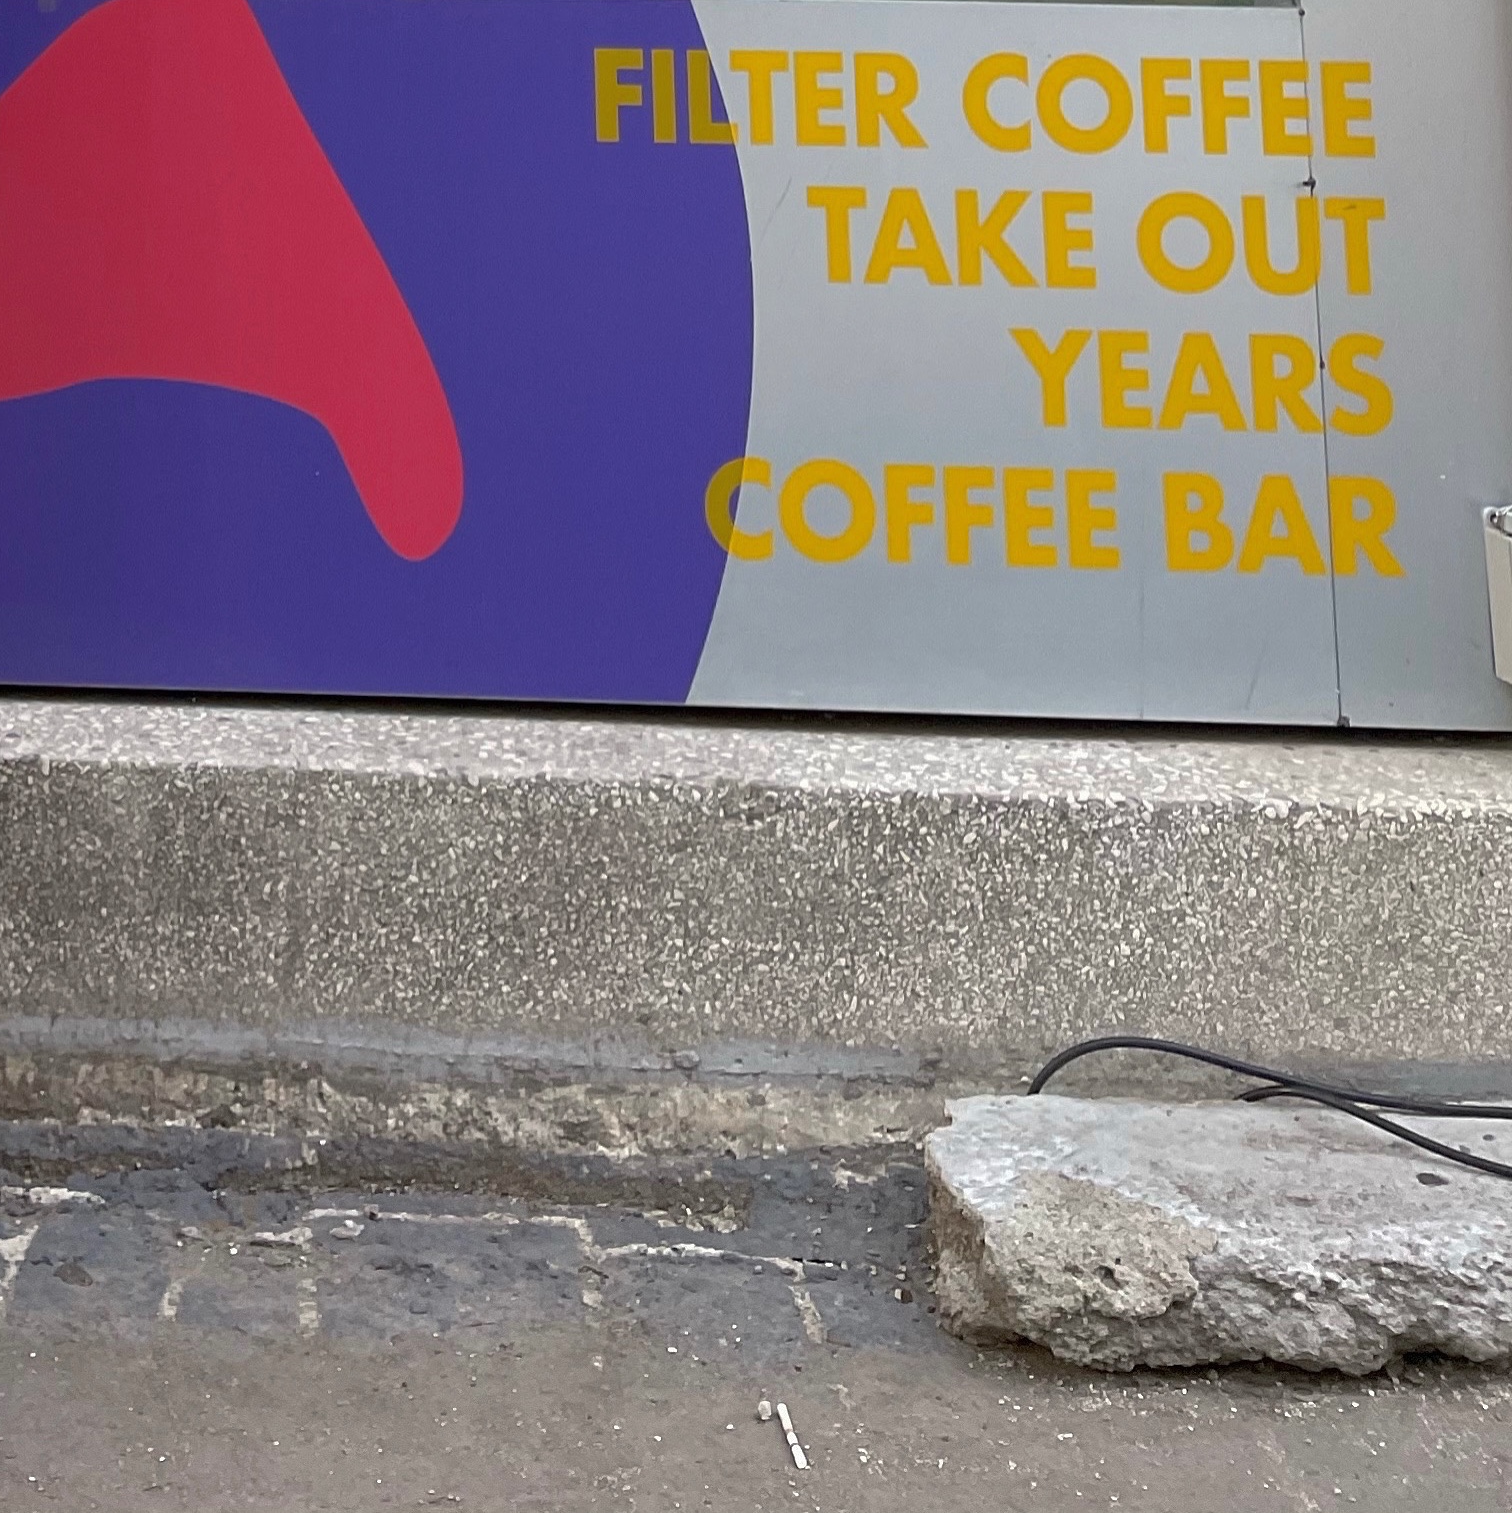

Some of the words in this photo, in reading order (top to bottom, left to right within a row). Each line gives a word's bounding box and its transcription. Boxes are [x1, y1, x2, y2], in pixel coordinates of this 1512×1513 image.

[593, 47, 929, 148] FILTER
[961, 52, 1377, 158] COFFEE
[806, 185, 1097, 289] TAKE
[1135, 191, 1386, 296] OUT
[1008, 328, 1395, 436] YEARS
[704, 457, 1121, 569] COFFEE
[1161, 471, 1406, 578] BAR
